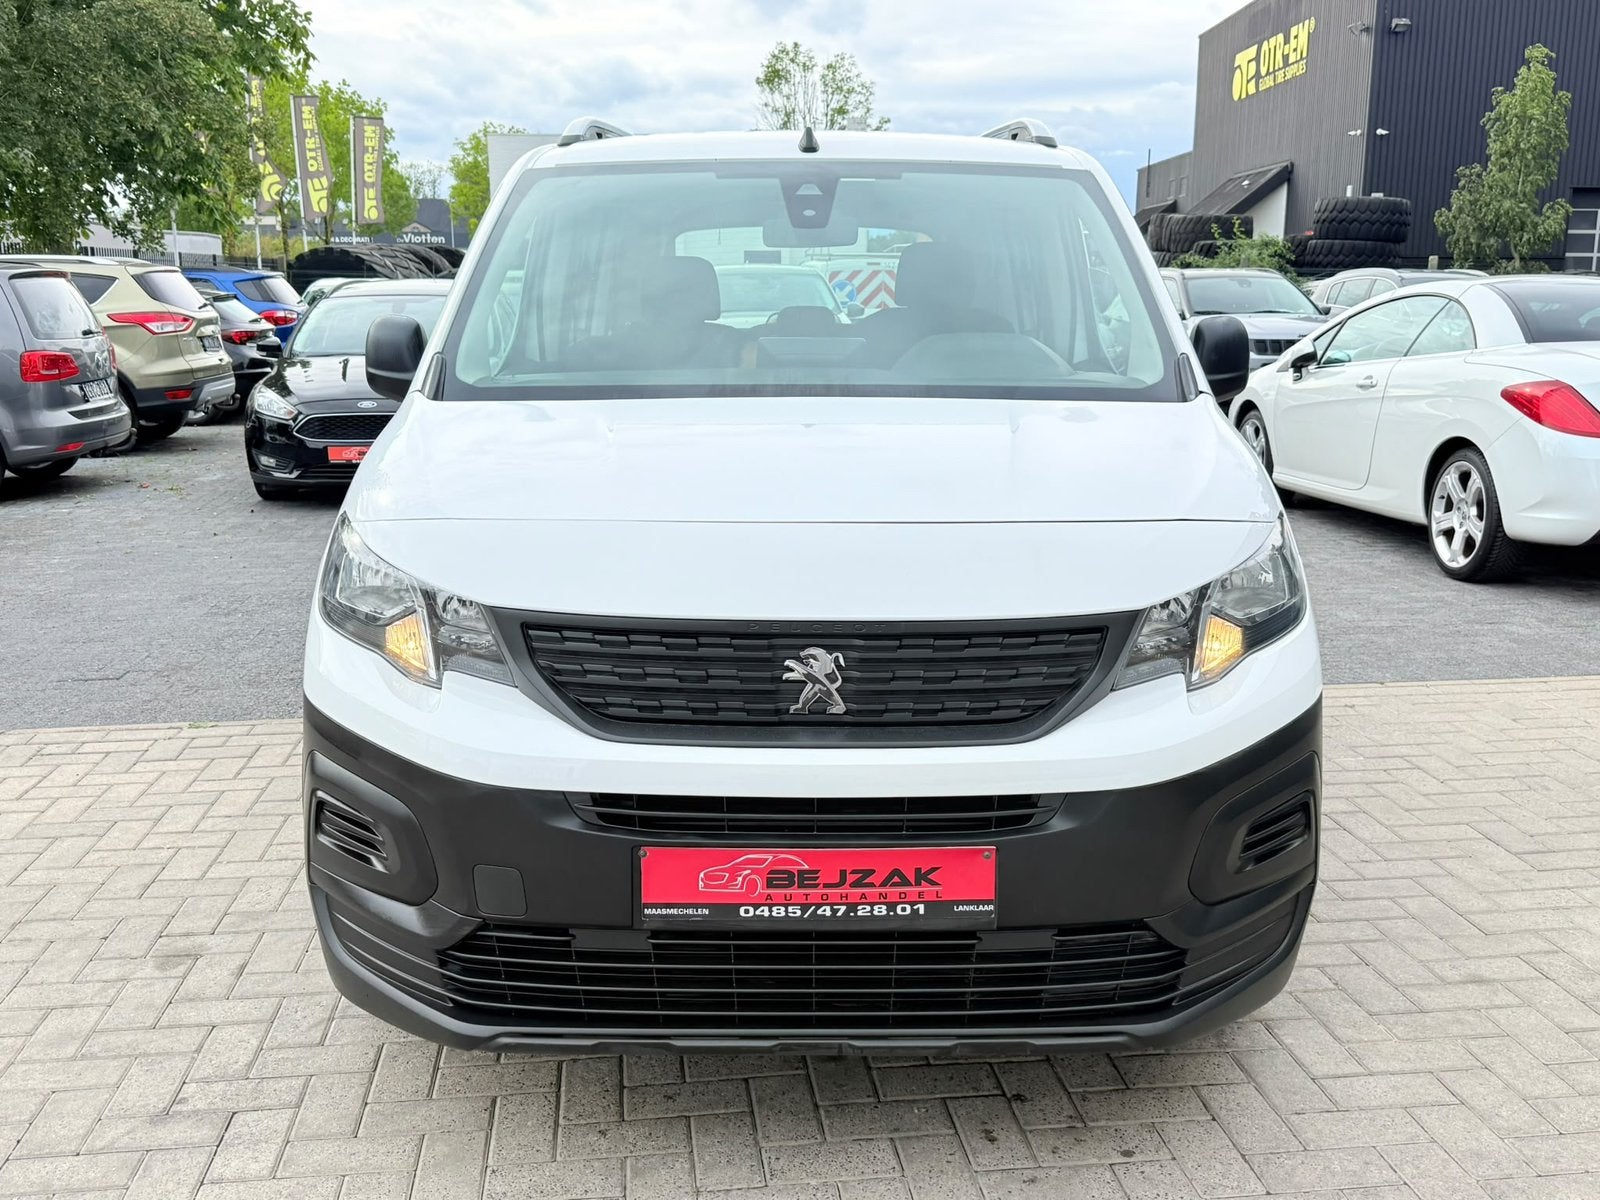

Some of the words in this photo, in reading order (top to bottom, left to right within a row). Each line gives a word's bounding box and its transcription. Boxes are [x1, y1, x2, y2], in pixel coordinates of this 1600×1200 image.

[302, 105, 318, 172] OTR-EM
[363, 125, 376, 183] OTR-EM
[403, 232, 446, 244] Vlotten
[749, 622, 887, 633] PEUGEOT
[766, 866, 943, 889] BEJZAK
[765, 891, 943, 902] AUTOHANDEL
[739, 904, 925, 918] 0485/47.28.01
